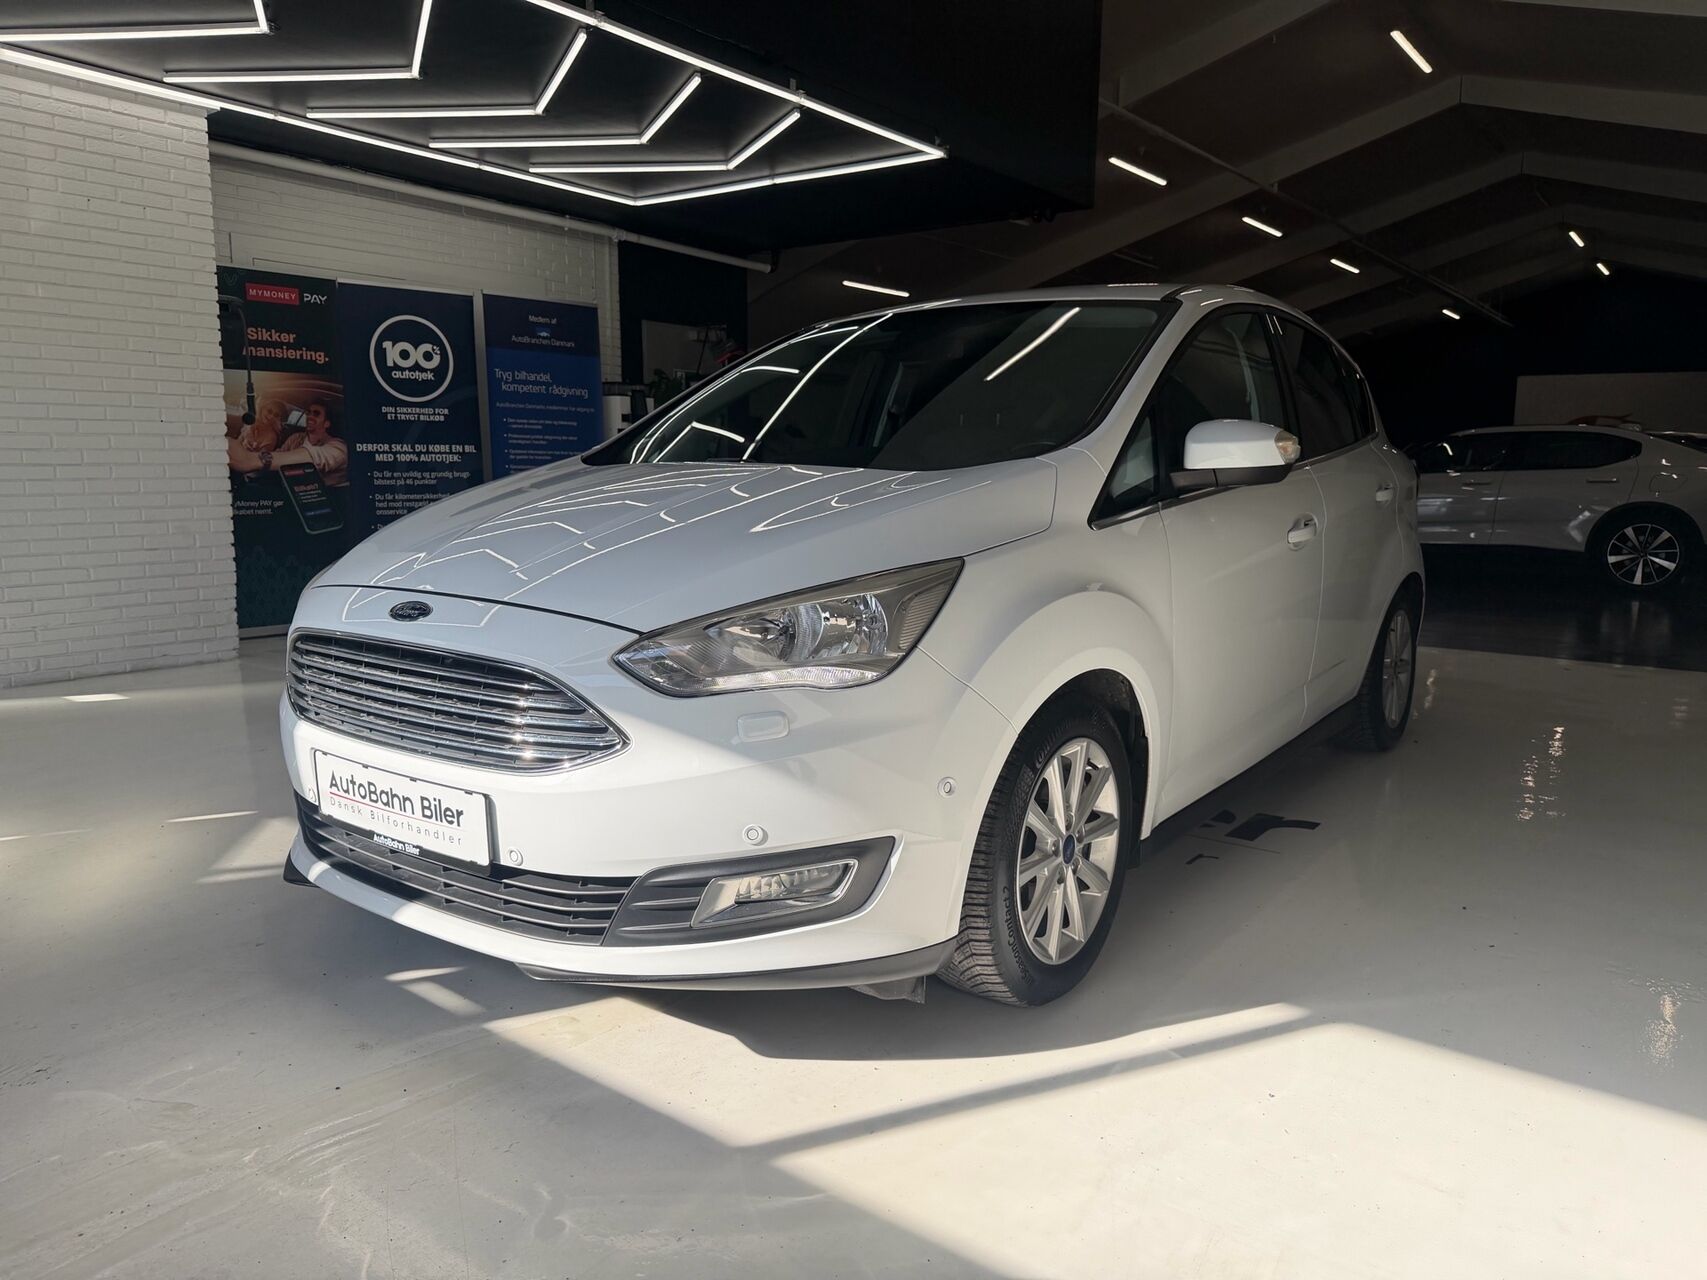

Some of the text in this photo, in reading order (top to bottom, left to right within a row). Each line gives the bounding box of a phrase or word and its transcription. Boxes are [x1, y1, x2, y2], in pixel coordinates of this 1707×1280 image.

[249, 289, 328, 304] MYMONEY PAY
[247, 327, 296, 343] Sikker
[392, 370, 434, 381] autotjek
[494, 368, 512, 382] Tryg
[502, 382, 588, 399] kompetent rådgivning
[356, 444, 390, 452] DERFOR
[392, 444, 413, 452] SKAL
[415, 444, 427, 452] DU
[428, 444, 449, 452] KØBE
[465, 445, 476, 453] BIL
[375, 454, 462, 463] MED 100% AUTOTJEK:
[397, 478, 405, 486] på
[329, 770, 464, 827] AutoBahn Biler
[330, 796, 462, 846] Dansk Bilforhandler
[373, 834, 420, 856] AutoBahn Biler
